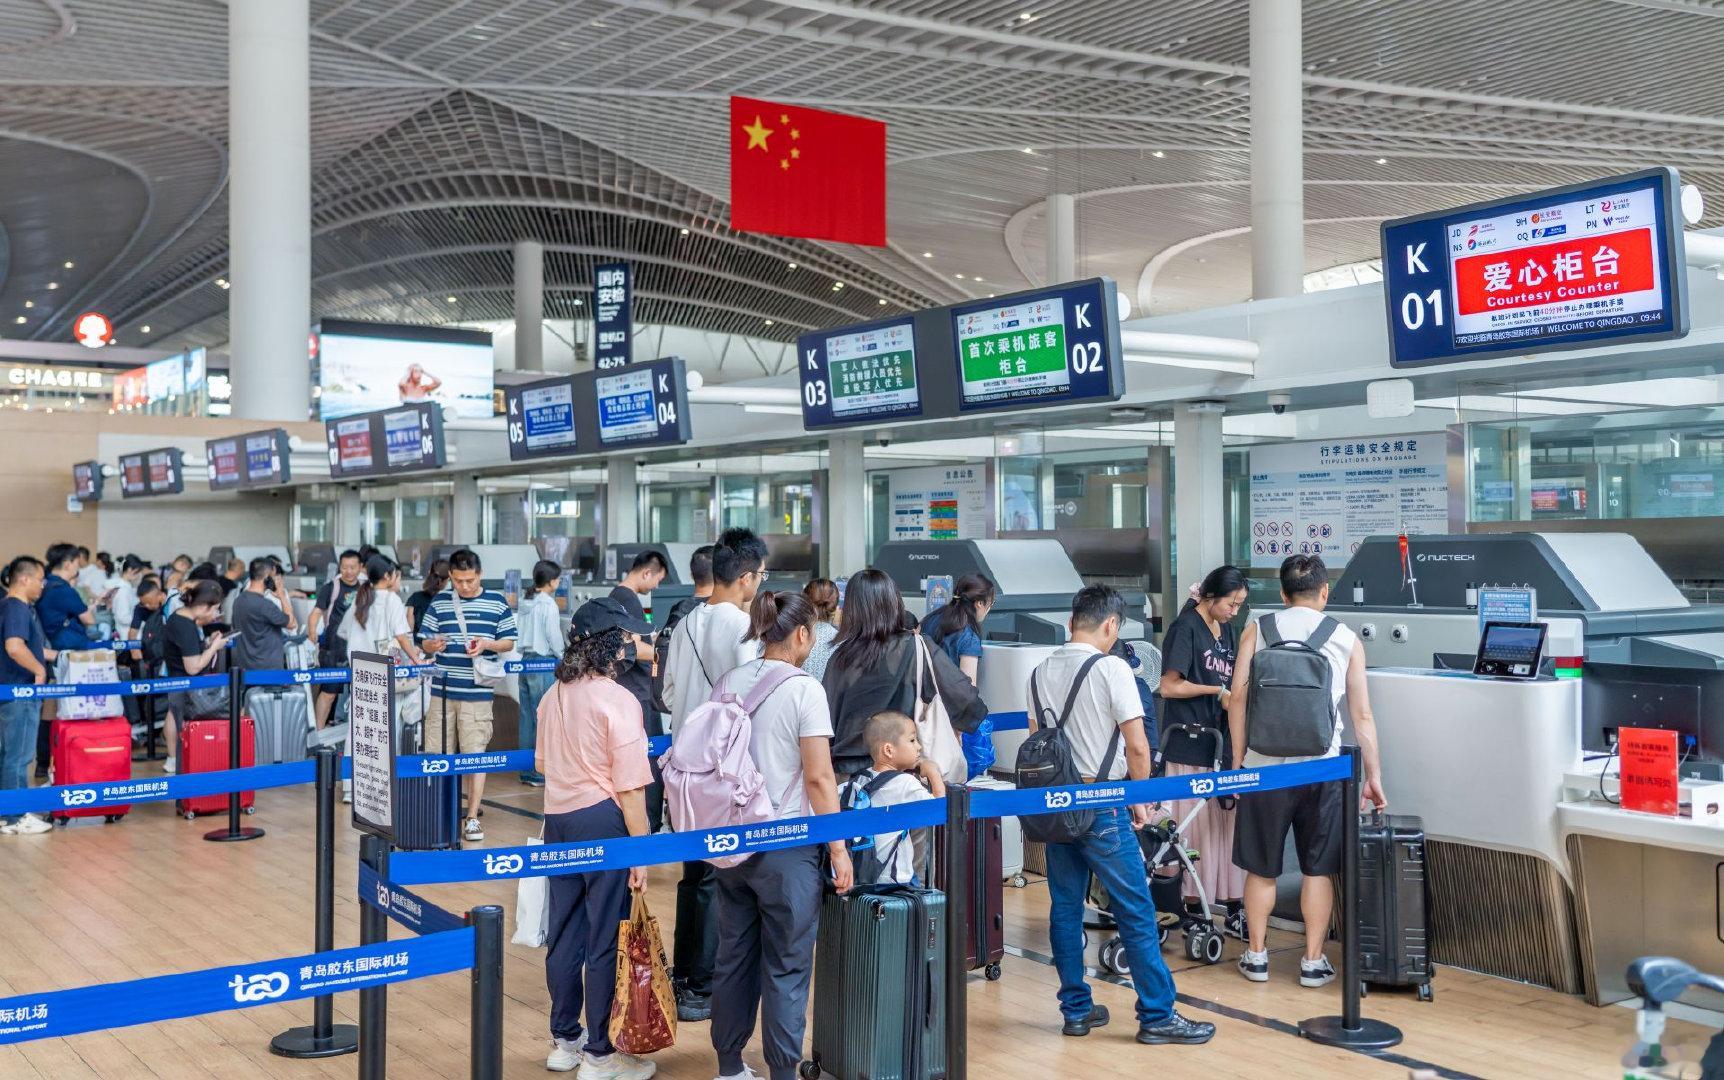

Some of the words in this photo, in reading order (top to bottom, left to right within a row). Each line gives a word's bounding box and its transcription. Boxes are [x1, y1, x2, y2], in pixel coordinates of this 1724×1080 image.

[1586, 204, 1594, 214] LT
[1516, 218, 1527, 226] 9H
[1586, 220, 1597, 228] PN
[1452, 229, 1461, 238] JD
[1453, 244, 1462, 252] NS
[1407, 243, 1429, 275] K
[598, 270, 625, 287] 国内
[1484, 246, 1621, 293] 爱心柜台
[598, 286, 625, 304] 安检
[1487, 290, 1552, 306] Courtesy
[1558, 280, 1619, 297] Counter
[1075, 302, 1091, 328] K
[1402, 289, 1443, 330] 01
[1548, 321, 1583, 332] WELCOME
[968, 331, 1056, 358] 首次乘机旅客
[806, 350, 818, 370] K
[999, 357, 1027, 375] 柜台
[1072, 342, 1104, 374] 02
[659, 374, 668, 393] K
[805, 380, 827, 406] 03
[510, 399, 518, 415] K
[658, 401, 676, 425] 04
[422, 413, 429, 430] K
[510, 423, 523, 443] 05
[422, 435, 433, 454] 06
[1321, 440, 1417, 457] 行李运输安全规定
[355, 668, 387, 687] 为确保飞行安全
[421, 759, 449, 773] tao
[103, 782, 168, 795] 青岛胶东国际机场
[1076, 787, 1125, 799] 青岛胶东国际机场
[1190, 779, 1214, 794] tao
[61, 789, 96, 806] tao
[1045, 791, 1072, 808] tao
[745, 823, 808, 839] 青岛胶东国际机场
[704, 833, 739, 853] tao
[530, 846, 604, 862] 青岛胶东国际机场
[482, 853, 523, 874] tao
[300, 952, 409, 981] 青岛胶东国际机场
[229, 972, 290, 1002] tao
